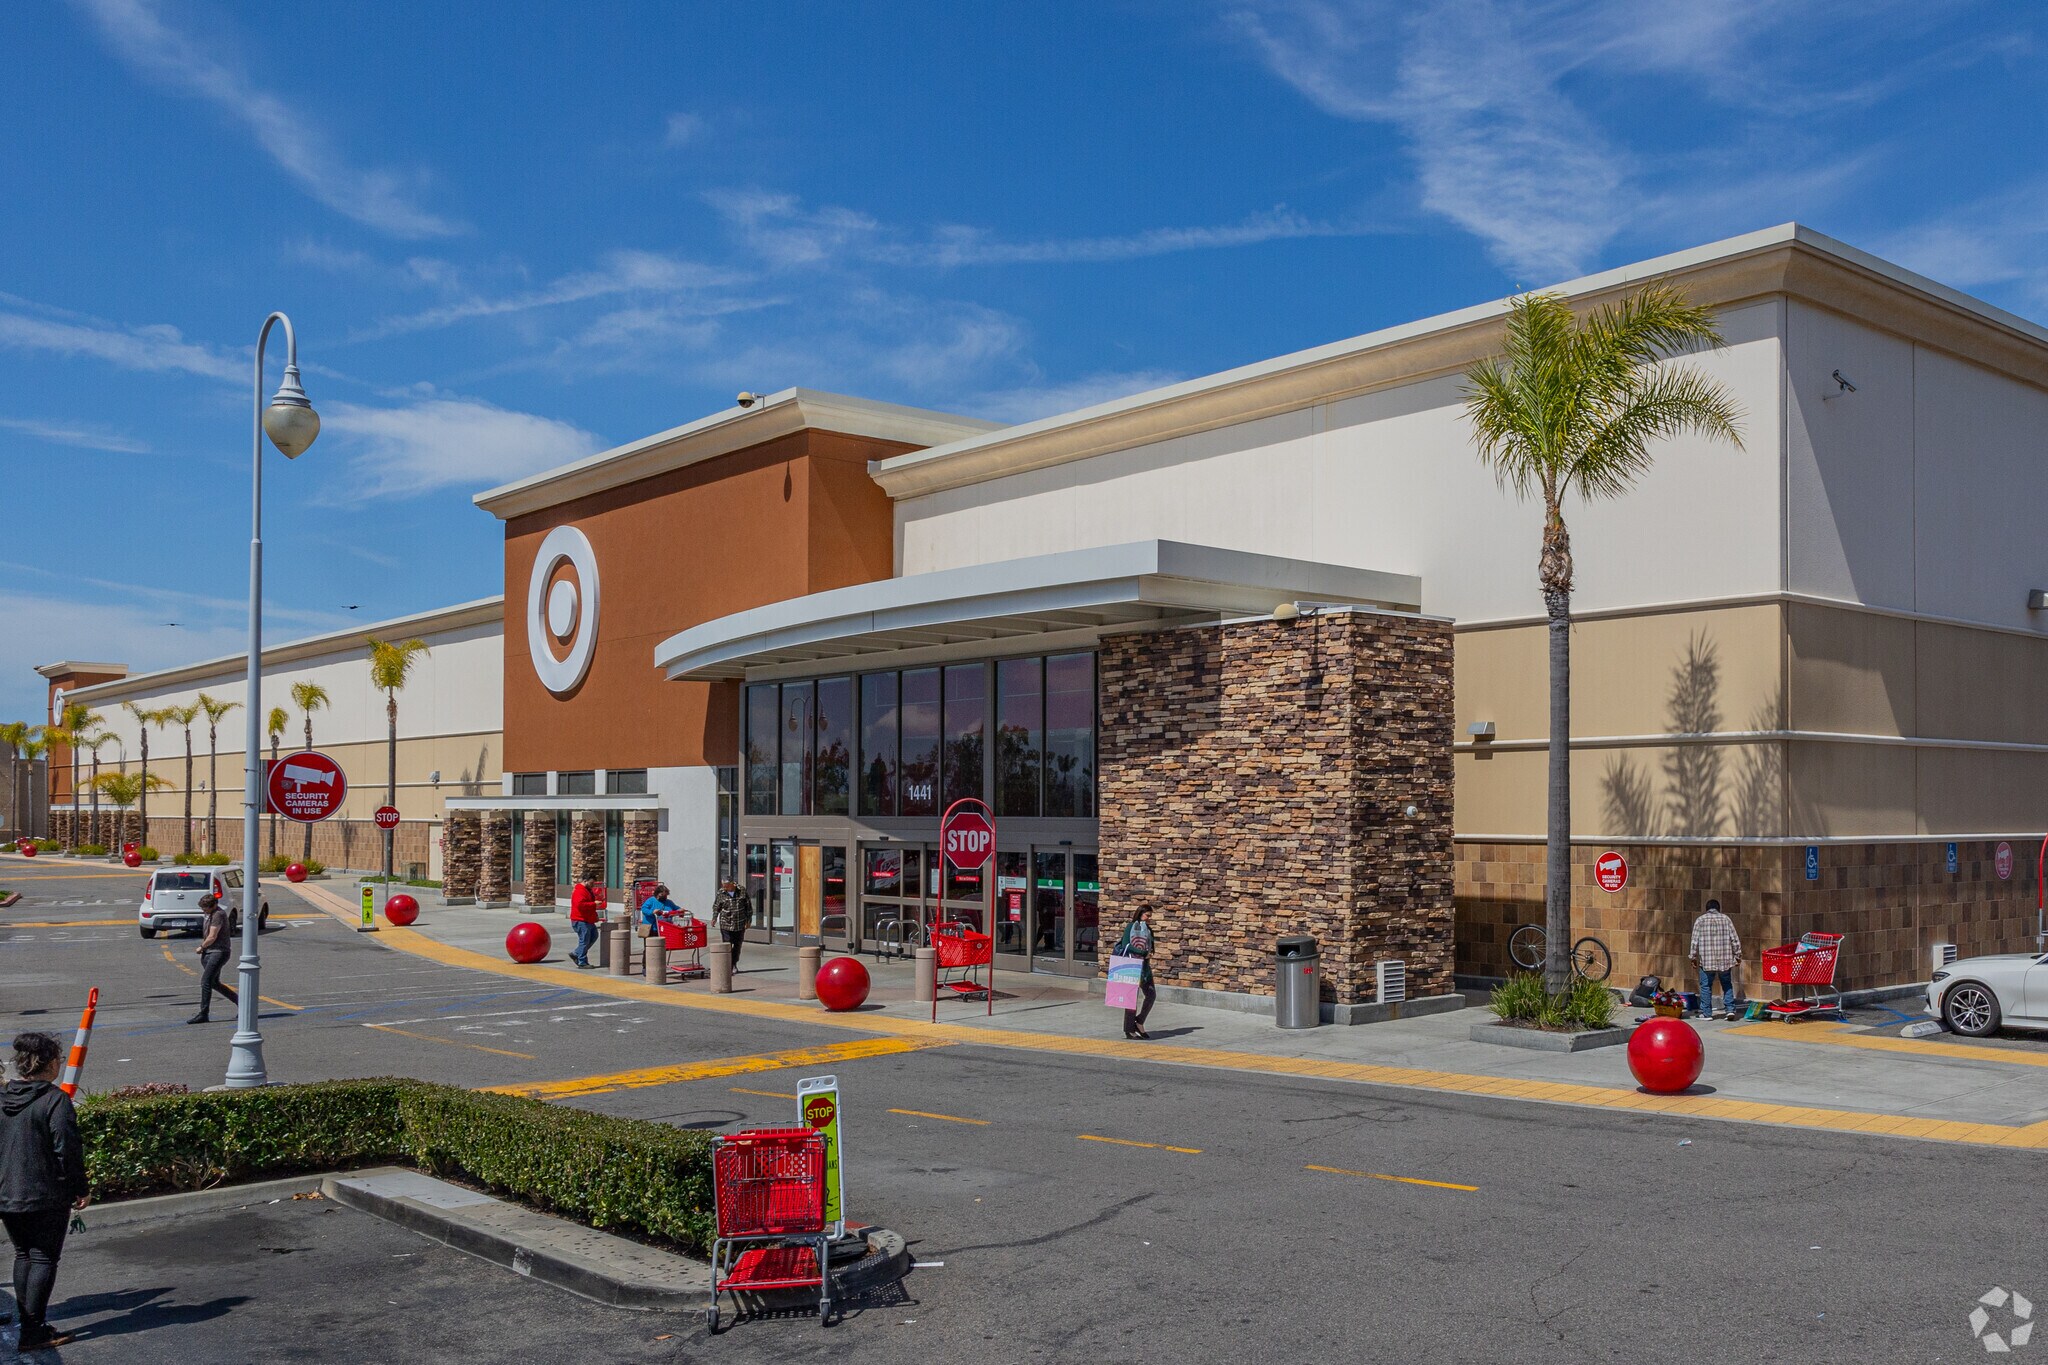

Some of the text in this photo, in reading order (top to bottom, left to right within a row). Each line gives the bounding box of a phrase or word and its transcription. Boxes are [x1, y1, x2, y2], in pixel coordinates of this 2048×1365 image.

[908, 784, 932, 801] 1441
[375, 812, 399, 822] STOP
[947, 830, 990, 852] STOP
[807, 1106, 833, 1120] STOP
